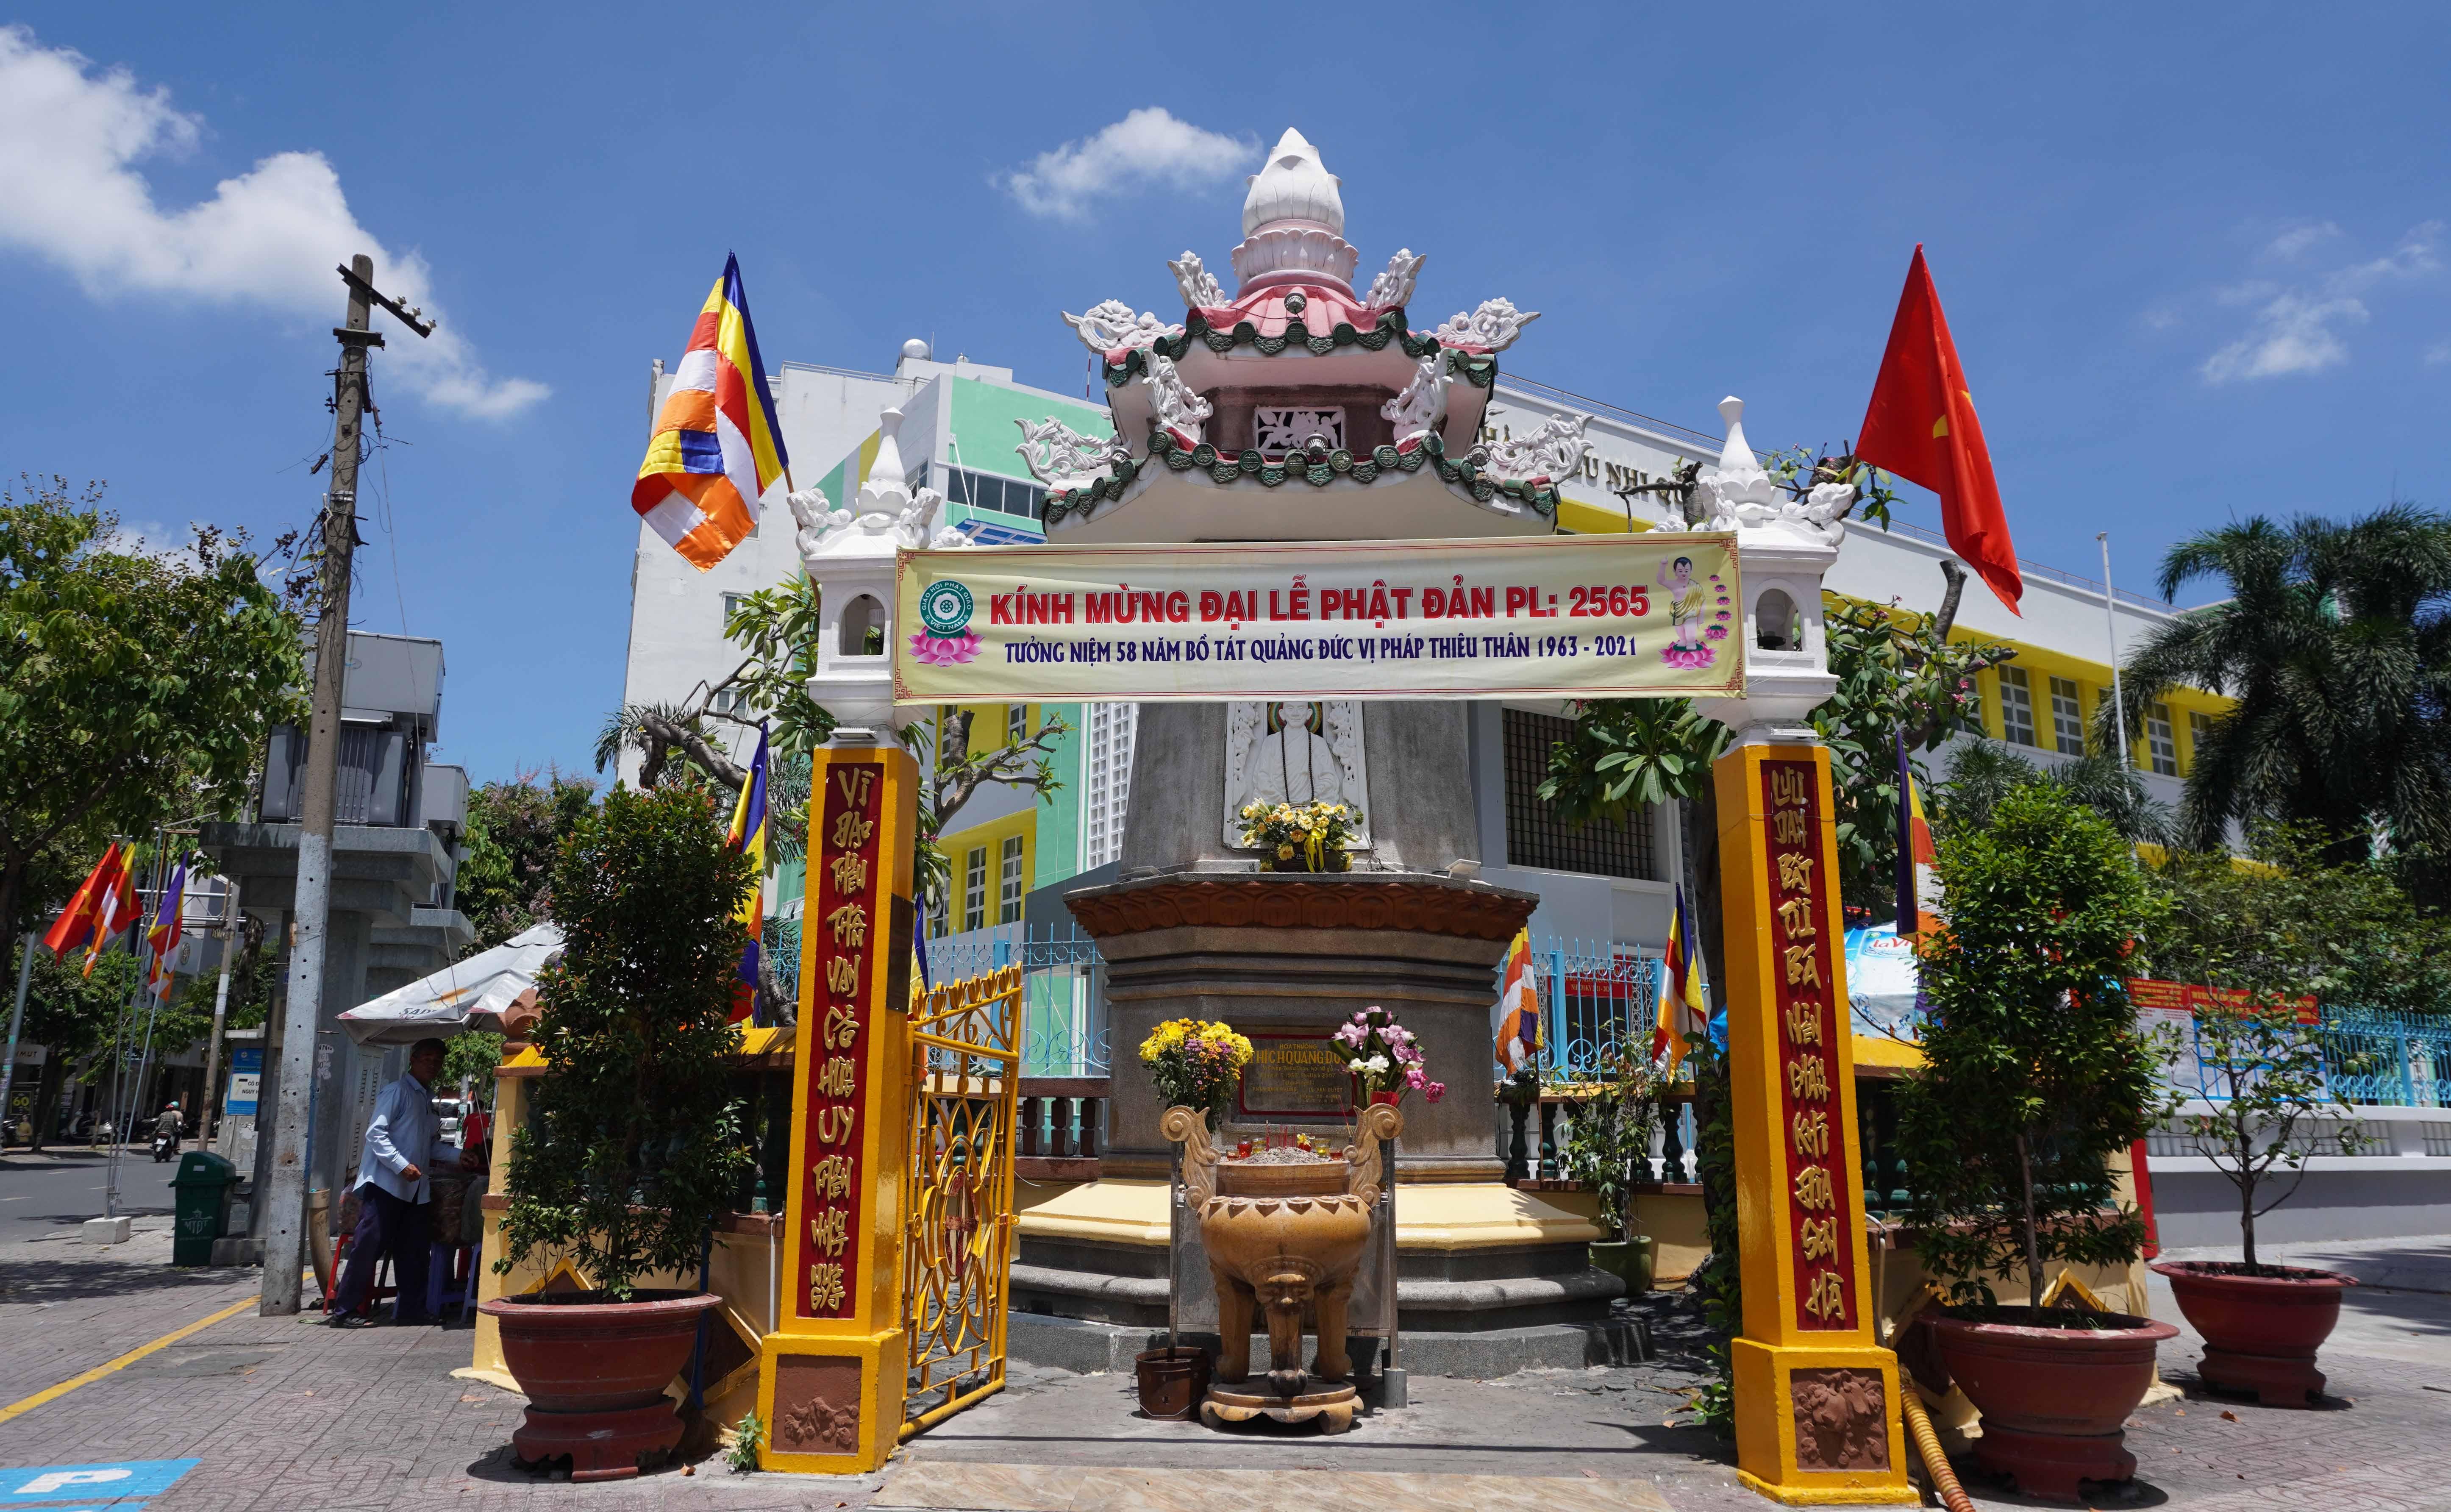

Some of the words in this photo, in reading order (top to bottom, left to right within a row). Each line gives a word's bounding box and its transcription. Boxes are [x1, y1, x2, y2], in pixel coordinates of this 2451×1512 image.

[1605, 461, 1649, 494] NHI
[922, 592, 931, 610] GIÁO
[930, 583, 943, 592] HỘI
[945, 582, 964, 591] PHẬT
[963, 592, 972, 610] GIÁO
[990, 584, 1074, 625] KÍNH
[1086, 583, 1189, 623] MỪNG
[1199, 589, 1258, 630] ĐẠI
[1270, 574, 1310, 621] LỄ
[1320, 579, 1413, 629] PHẬT
[1422, 573, 1495, 619] ĐẢN
[1506, 585, 1558, 618] PL:
[1569, 584, 1651, 617] 2565
[930, 620, 946, 630] VIỆT
[948, 619, 964, 630] NAM
[1005, 636, 1064, 663] TƯỞNG
[1070, 637, 1110, 667] NIỆM
[1117, 642, 1136, 662] 58
[1142, 637, 1180, 662] NĂM
[1186, 634, 1210, 661] BỒ
[1214, 636, 1246, 661] TÁT
[1251, 632, 1313, 663] QUẢNG
[1319, 634, 1353, 659] ĐỨC
[1359, 639, 1375, 663] VỊ
[1381, 633, 1424, 659] PHÁP
[1429, 633, 1477, 659] THIÊU
[1483, 632, 1530, 658] THÂN
[1538, 636, 1578, 657] 1963
[1595, 636, 1636, 656] 2021
[826, 902, 867, 948] THÂN
[1784, 944, 1821, 989] BÁ
[13, 1097, 30, 1106] 60
[818, 1106, 854, 1145] UY
[14, 1470, 132, 1494] P
